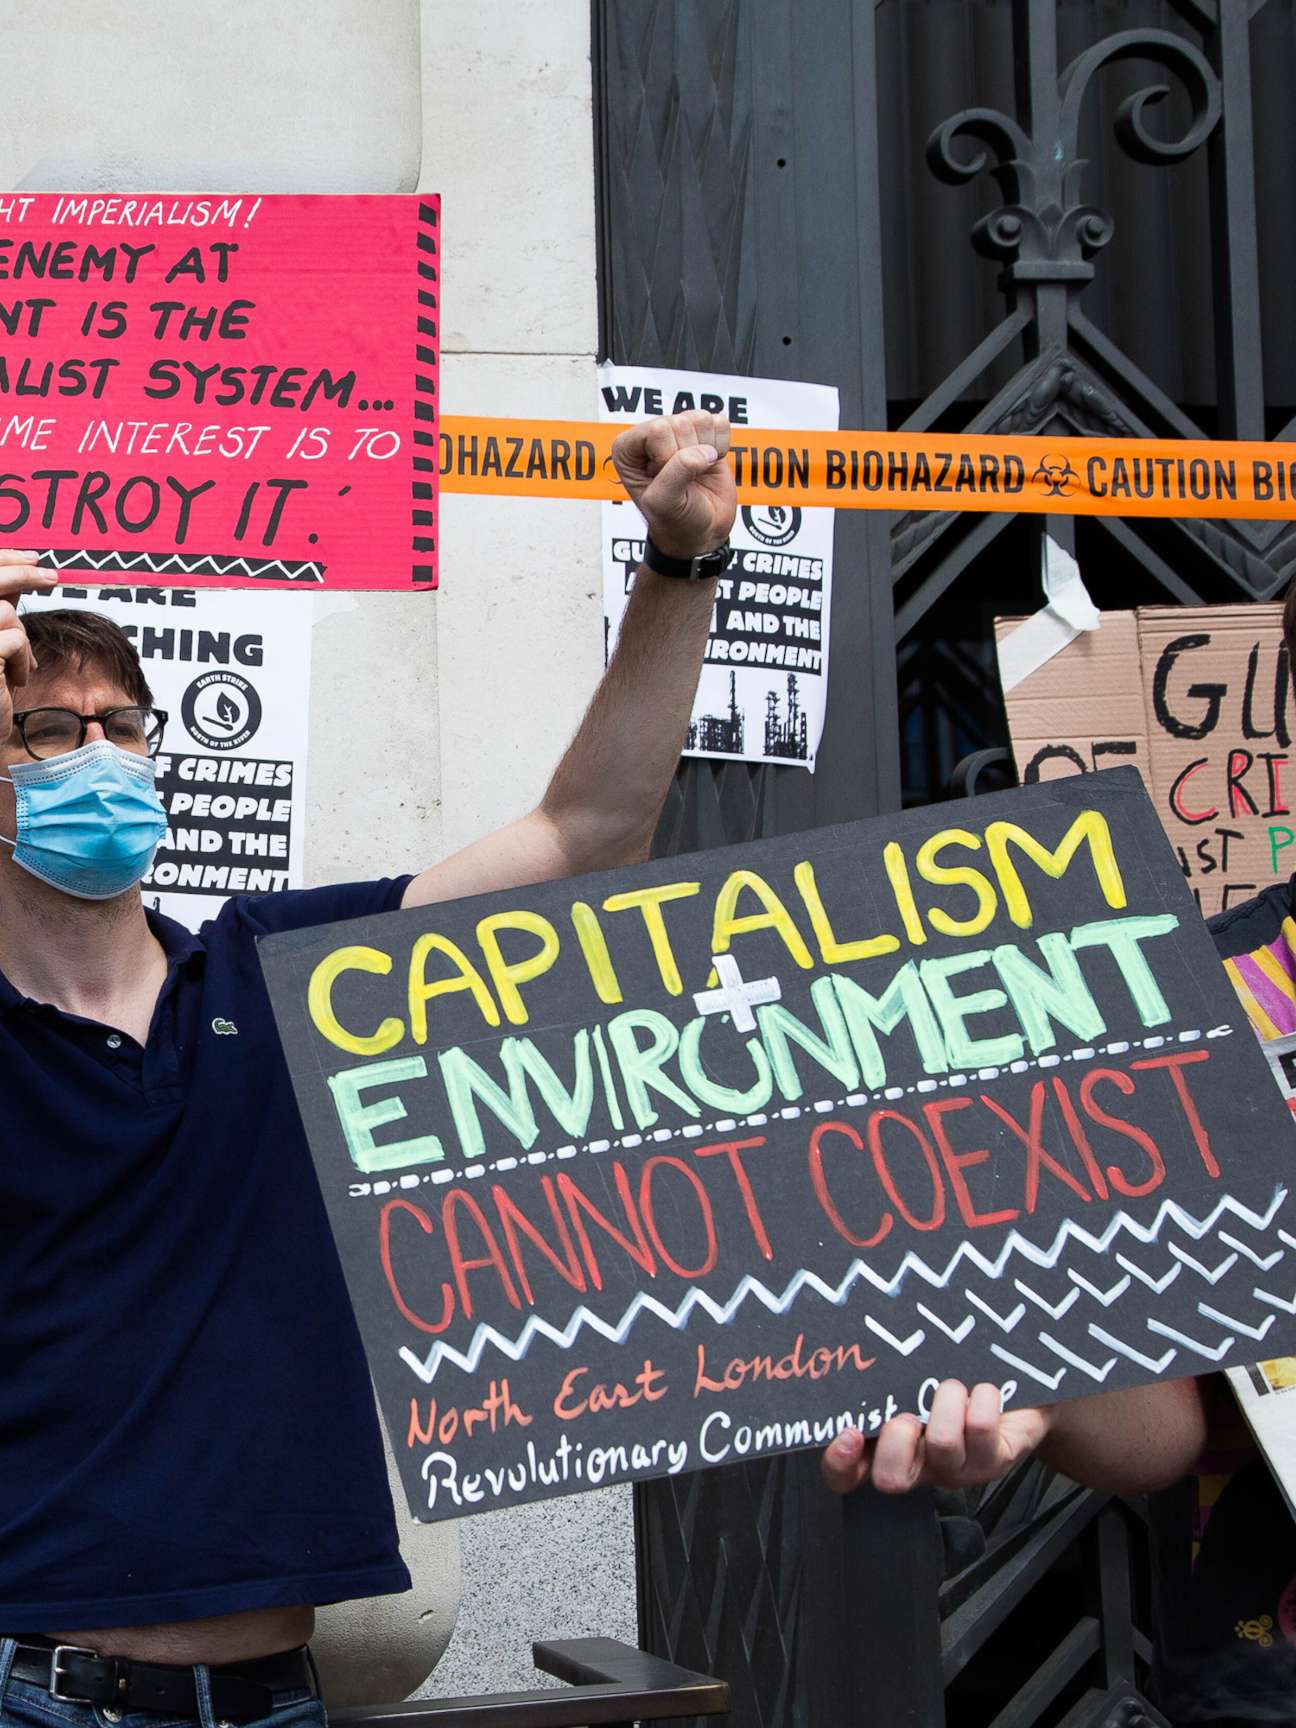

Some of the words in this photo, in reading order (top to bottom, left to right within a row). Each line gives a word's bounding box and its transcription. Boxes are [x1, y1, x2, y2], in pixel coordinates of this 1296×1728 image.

[51, 197, 262, 229] IMPERIALISM!
[165, 242, 239, 284] AT
[81, 301, 128, 339] IS
[150, 299, 256, 341] THE
[601, 386, 664, 416] WE
[77, 420, 272, 460] INTEREST
[285, 427, 332, 460] IS
[347, 427, 402, 461] TO
[826, 450, 1025, 494] BIOHAZARD
[1087, 456, 1237, 500] CAUTION
[742, 552, 824, 581] CRIMES
[738, 581, 823, 611] PEOPLE
[726, 609, 780, 633] AND
[783, 616, 821, 641] THE
[177, 757, 292, 788] CRIMES
[169, 792, 292, 823] PEOPLE
[157, 828, 223, 853] AND
[227, 832, 288, 858] THE
[307, 810, 1128, 1057] CAPITALISM
[326, 913, 1181, 1175] ENVIRONMENT
[379, 1135, 774, 1336] CANNOT
[808, 1049, 1221, 1250] COEXIST
[406, 1379, 533, 1450] North
[552, 1360, 668, 1421] East
[695, 1334, 877, 1394] London
[420, 1432, 689, 1509] Revolutionary
[698, 1394, 900, 1465] Communist
